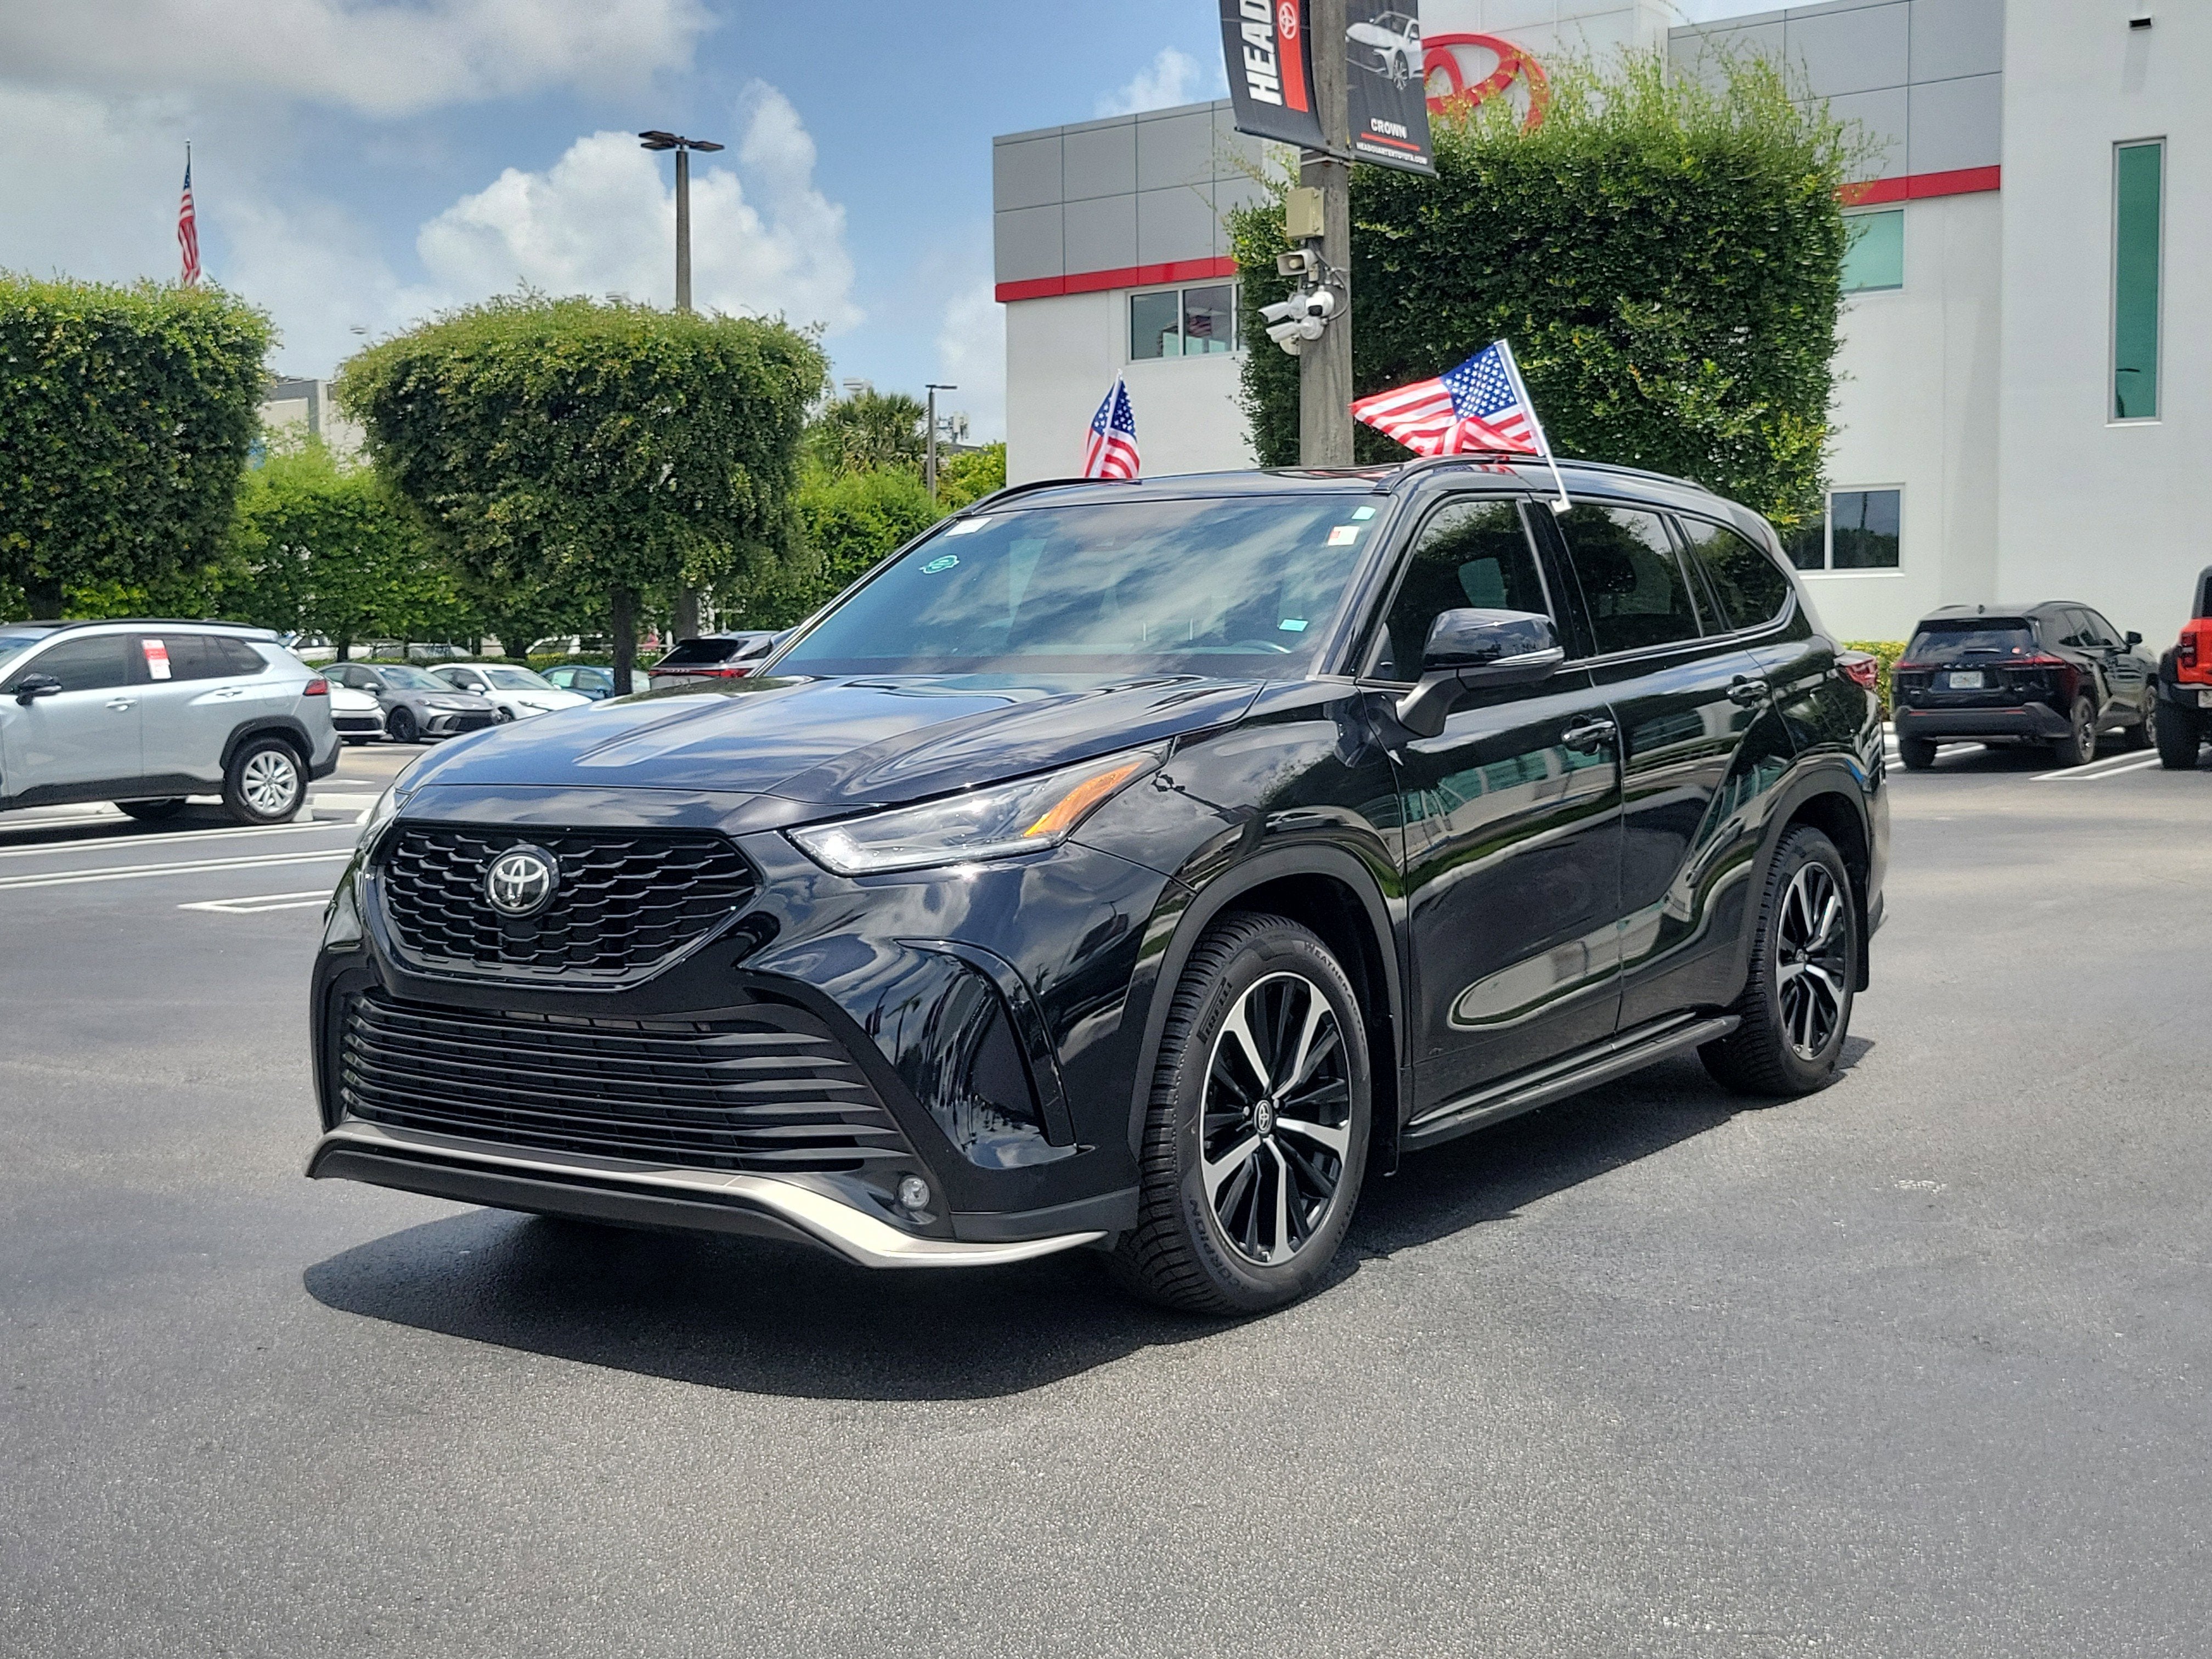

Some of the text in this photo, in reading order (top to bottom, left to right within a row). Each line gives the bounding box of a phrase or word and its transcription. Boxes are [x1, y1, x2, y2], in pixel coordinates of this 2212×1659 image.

[1239, 0, 1283, 106] HEAD
[1370, 117, 1407, 139] CROWN
[1197, 977, 1232, 1045] PIRELLI
